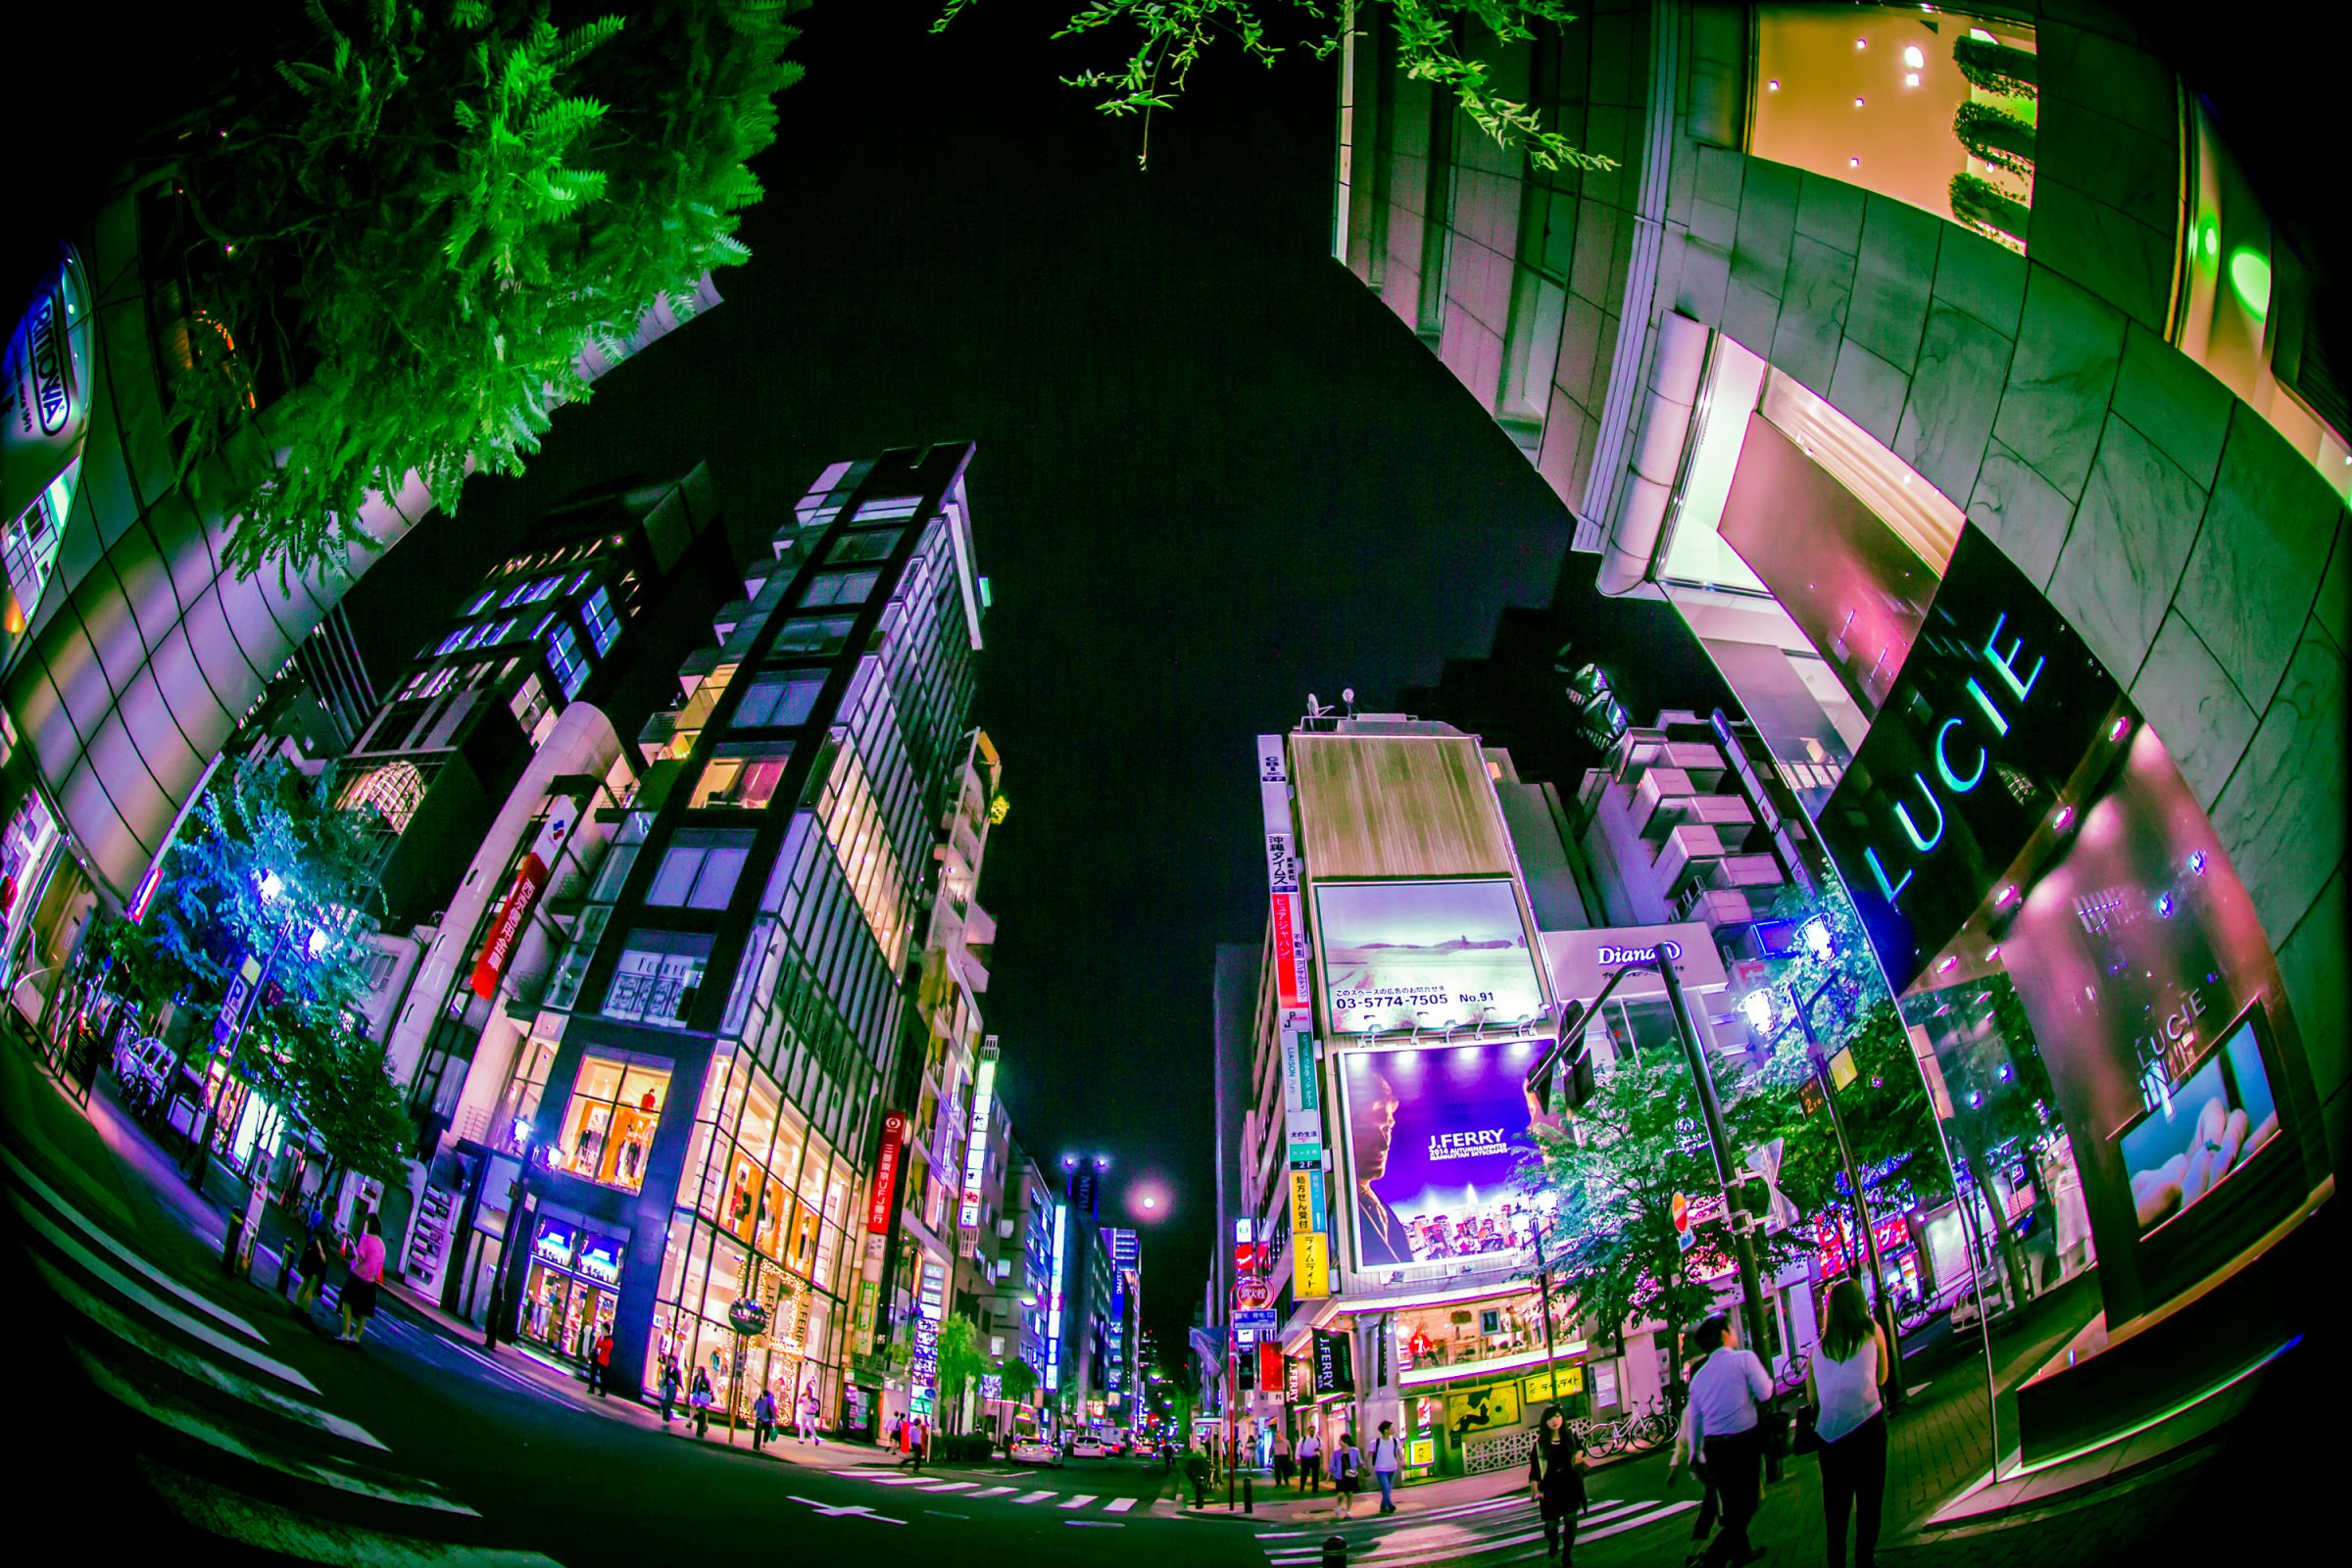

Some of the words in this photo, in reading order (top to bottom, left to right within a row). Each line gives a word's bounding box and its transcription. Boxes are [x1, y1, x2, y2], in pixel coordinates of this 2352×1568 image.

[1864, 611, 2047, 904] LUCIE
[1269, 836, 1288, 885] 沖縄タイムス
[1277, 897, 1291, 958] ピュアジャパン
[1336, 994, 1448, 1009] 03-5774-7505
[1459, 992, 1494, 1004] No.91
[2135, 988, 2207, 1070] LUCIE
[1299, 1160, 1313, 1169] 2F
[1428, 1128, 1504, 1150] J.FERRY
[873, 1144, 895, 1224] 三菱東京UFJ銀行
[1296, 1175, 1308, 1229] 処方せん受付
[1304, 1236, 1316, 1289] ライムライト
[1240, 1287, 1266, 1299] 消火栓
[1289, 1362, 1298, 1402] J.FERRY
[1319, 1337, 1334, 1390] J.FERRY
